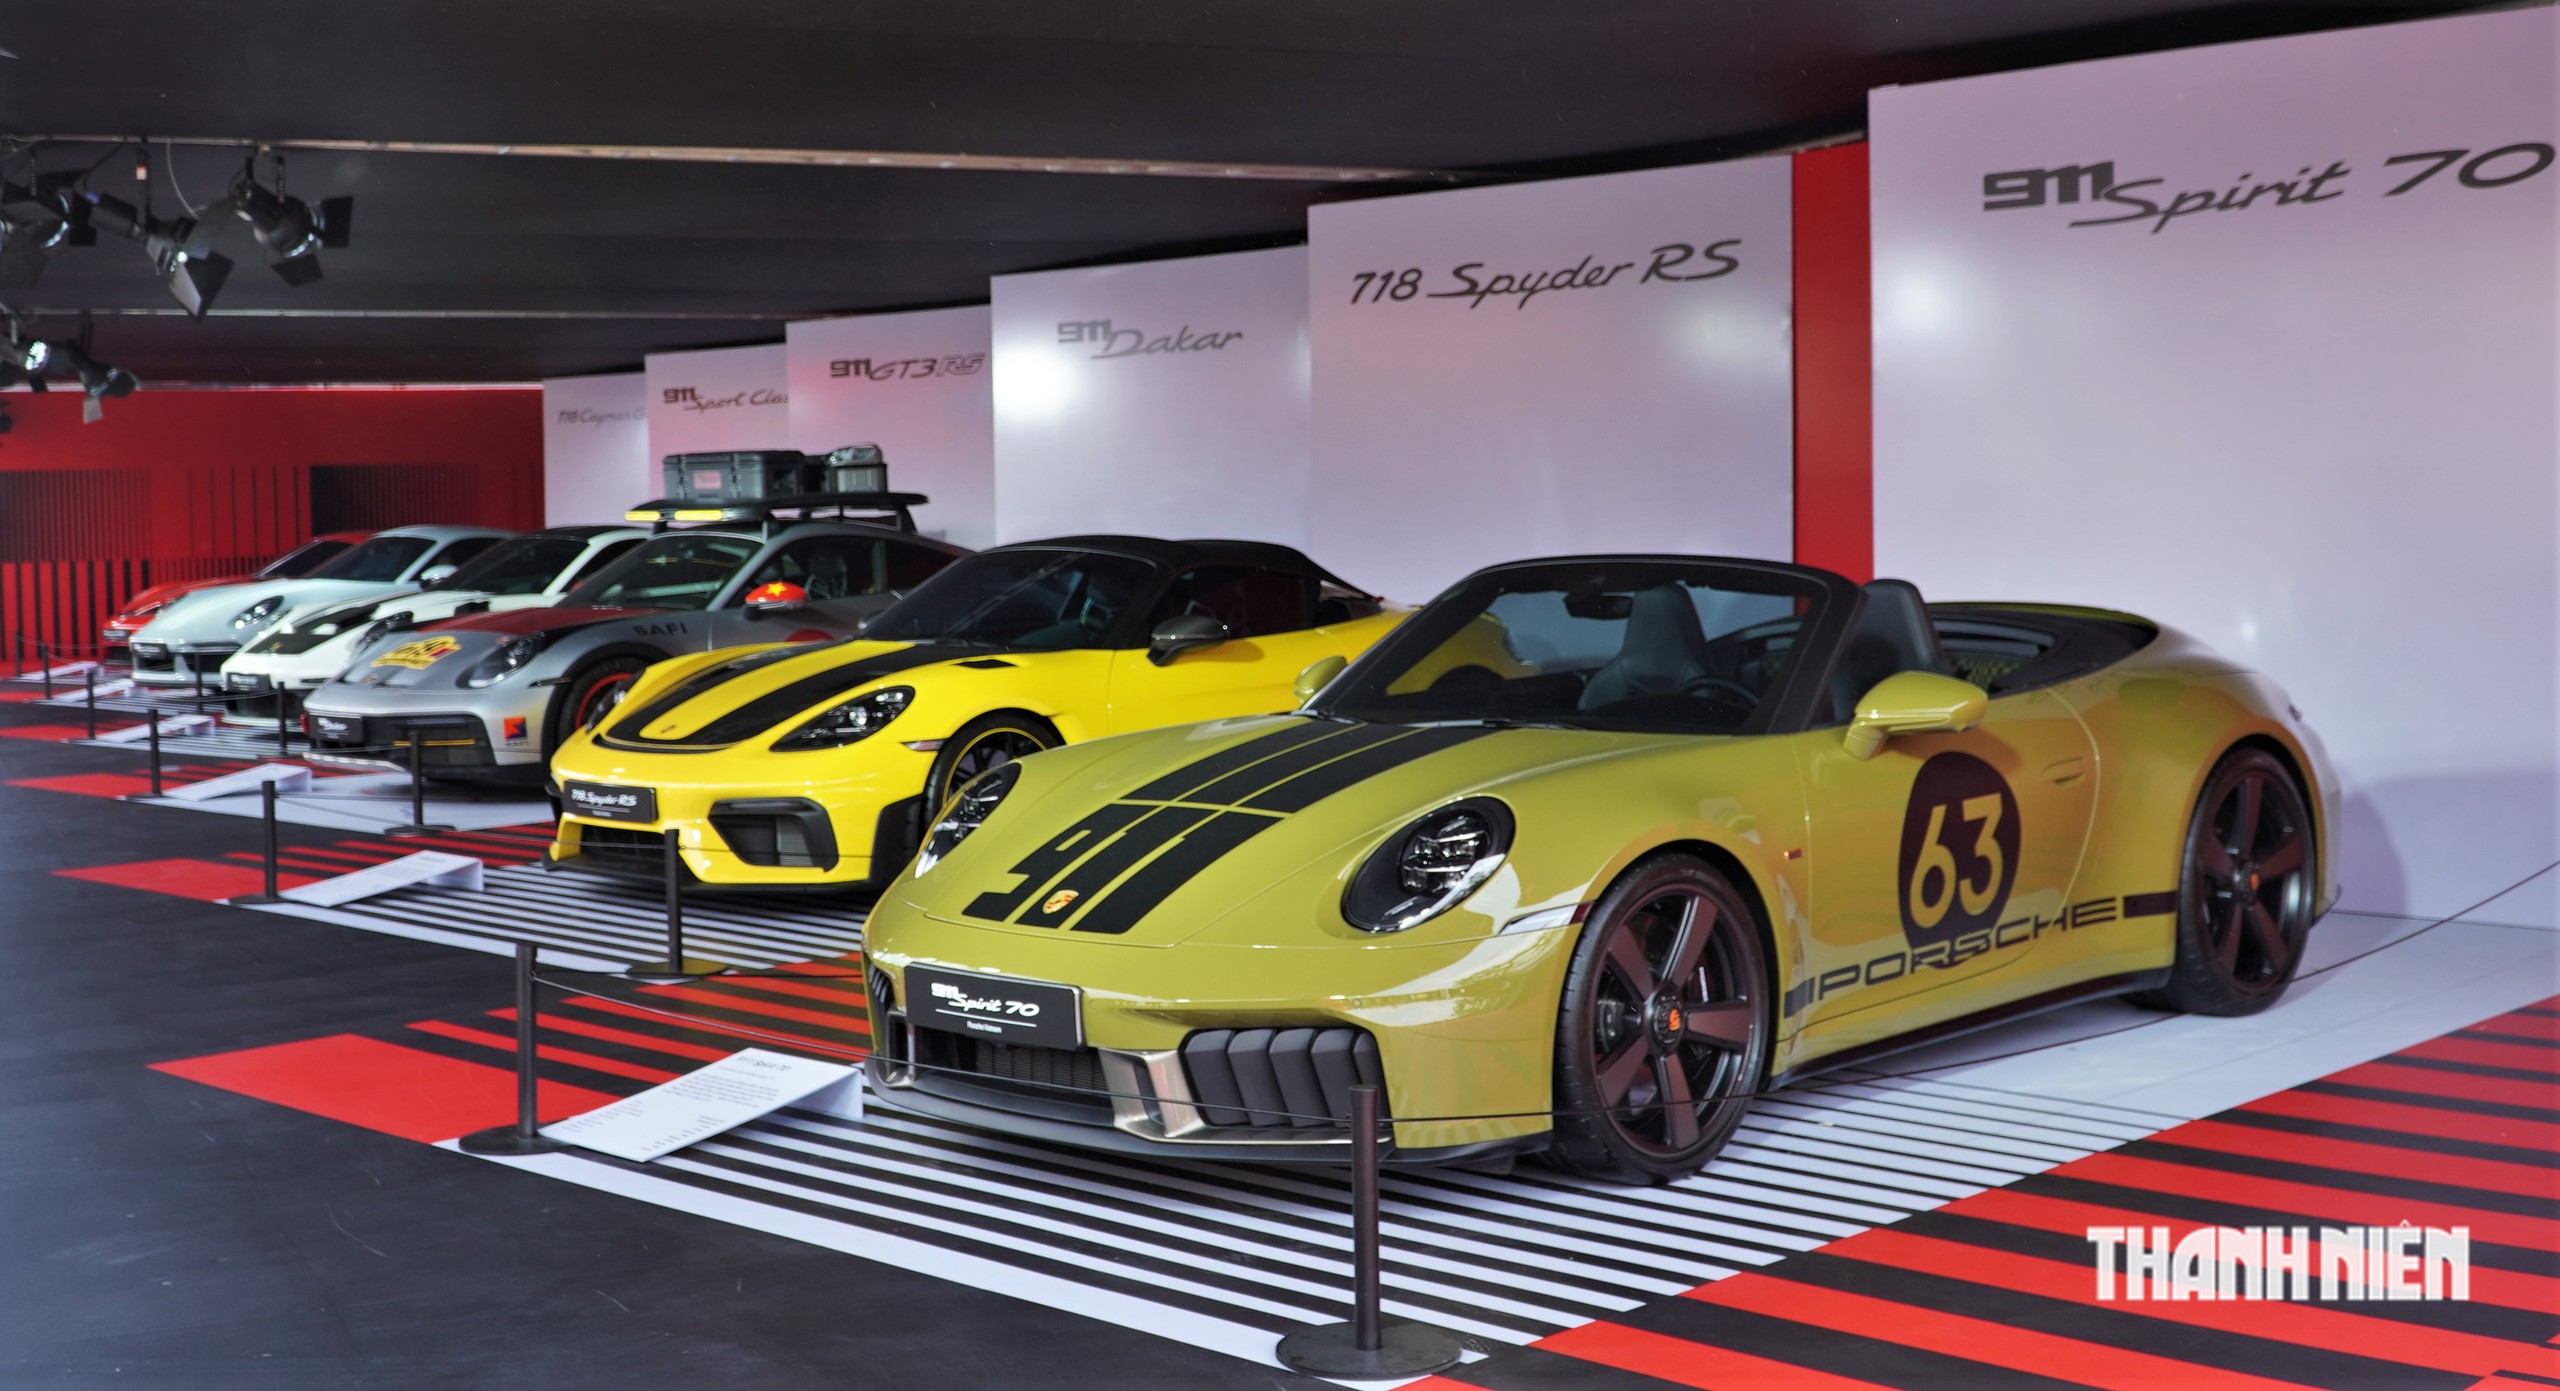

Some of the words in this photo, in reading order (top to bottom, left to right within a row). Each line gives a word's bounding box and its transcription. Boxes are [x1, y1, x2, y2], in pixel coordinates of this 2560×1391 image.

[1984, 160, 2114, 211] 911
[2069, 160, 2351, 235] Spirit
[2384, 142, 2556, 189] 70
[1351, 268, 1424, 304] 718
[1426, 256, 1635, 310] Spyder
[1640, 239, 1743, 284] RS
[1057, 319, 1112, 343] 911
[1090, 324, 1244, 360] Dakar
[830, 358, 871, 378] 911
[663, 386, 696, 404] 911
[682, 391, 747, 415] Sport
[633, 621, 687, 637] SAFI
[1910, 792, 2004, 929] 63
[1818, 897, 2118, 1001] PORSCHE
[948, 993, 1002, 1012] Spirit
[1005, 1000, 1040, 1017] 70
